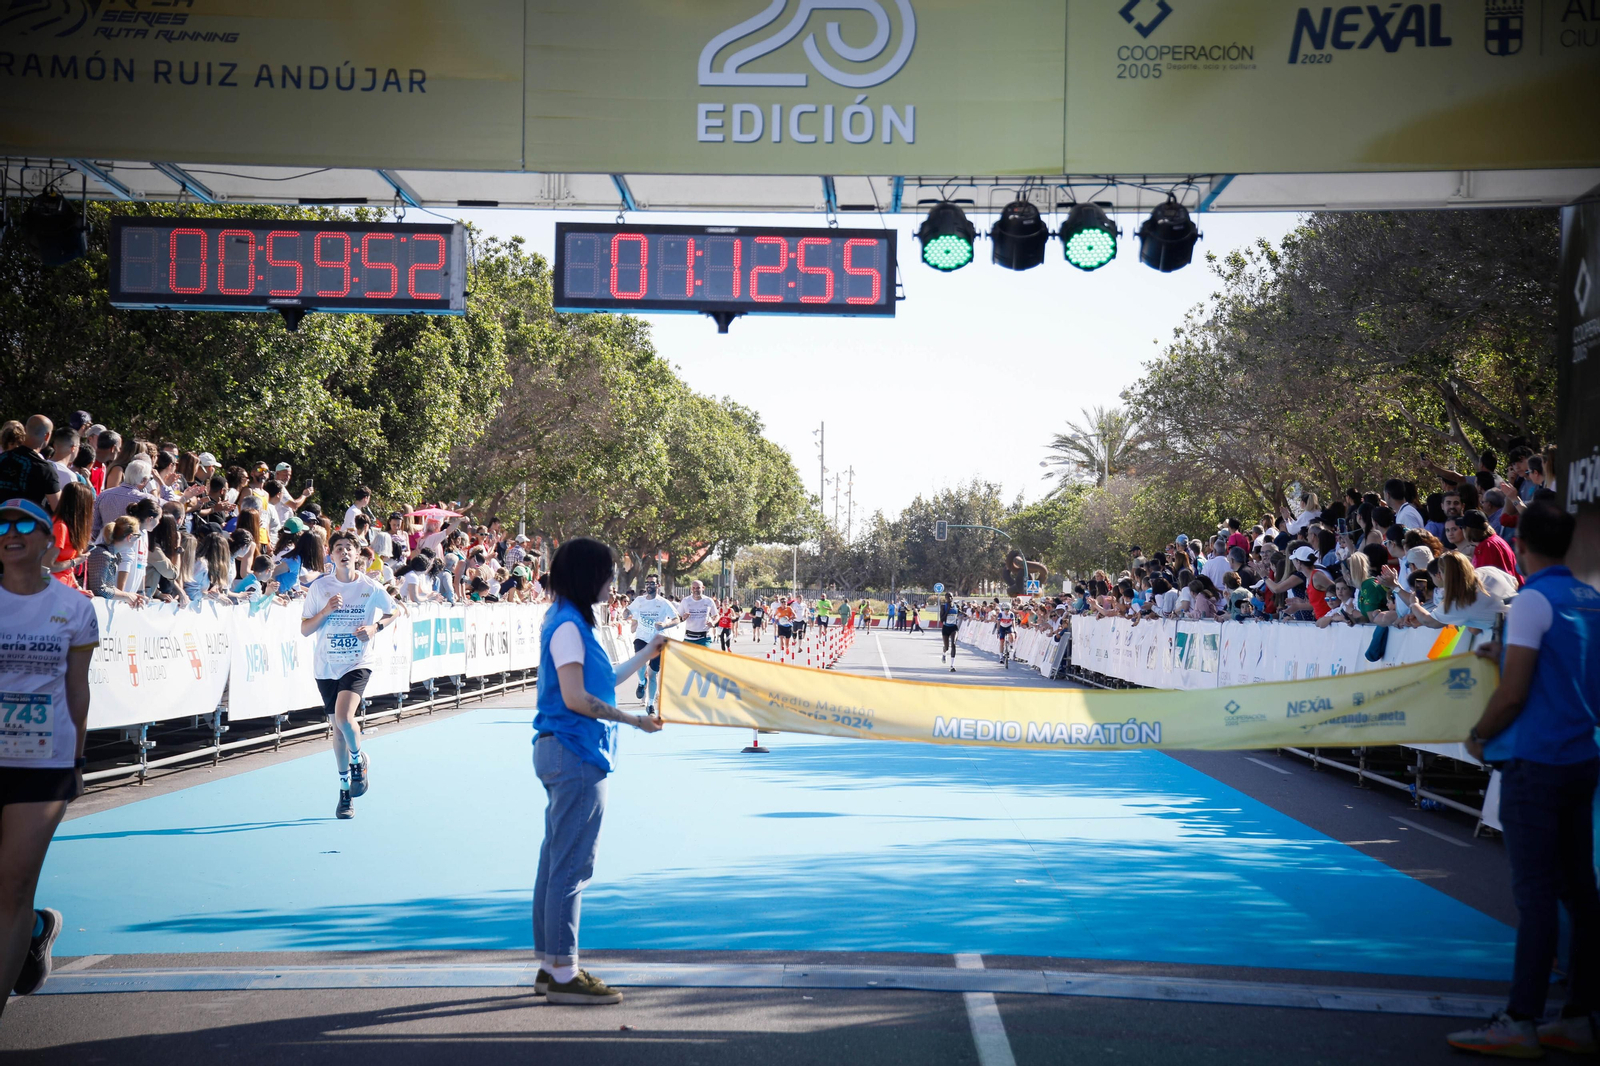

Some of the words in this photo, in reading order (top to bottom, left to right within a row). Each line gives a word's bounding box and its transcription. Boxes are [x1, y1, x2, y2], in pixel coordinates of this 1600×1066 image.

[101, 10, 189, 27] SERIES
[93, 27, 148, 40] RUTA
[155, 29, 240, 43] RUNNING
[1288, 3, 1452, 64] NEXAL
[1117, 42, 1254, 61] COOPERACIÓN
[1301, 54, 1332, 64] 2020
[0, 50, 134, 83] RAMÓN
[154, 60, 238, 87] RUIZ
[254, 61, 427, 93] ANDÚJAR
[1117, 63, 1162, 79] 2005
[697, 95, 915, 143] EDICIÓN
[610, 233, 881, 304] 01:12:55
[0, 641, 27, 651] ería
[29, 642, 62, 653] 2024
[16, 632, 62, 643] Maratón
[330, 638, 358, 648] 5482
[1, 703, 47, 725] 743
[769, 691, 810, 708] Medio
[815, 700, 875, 718] Maratón
[1286, 696, 1334, 718] NEXAL
[933, 716, 1022, 743] MEDIO
[1026, 718, 1162, 745] MARATÓN
